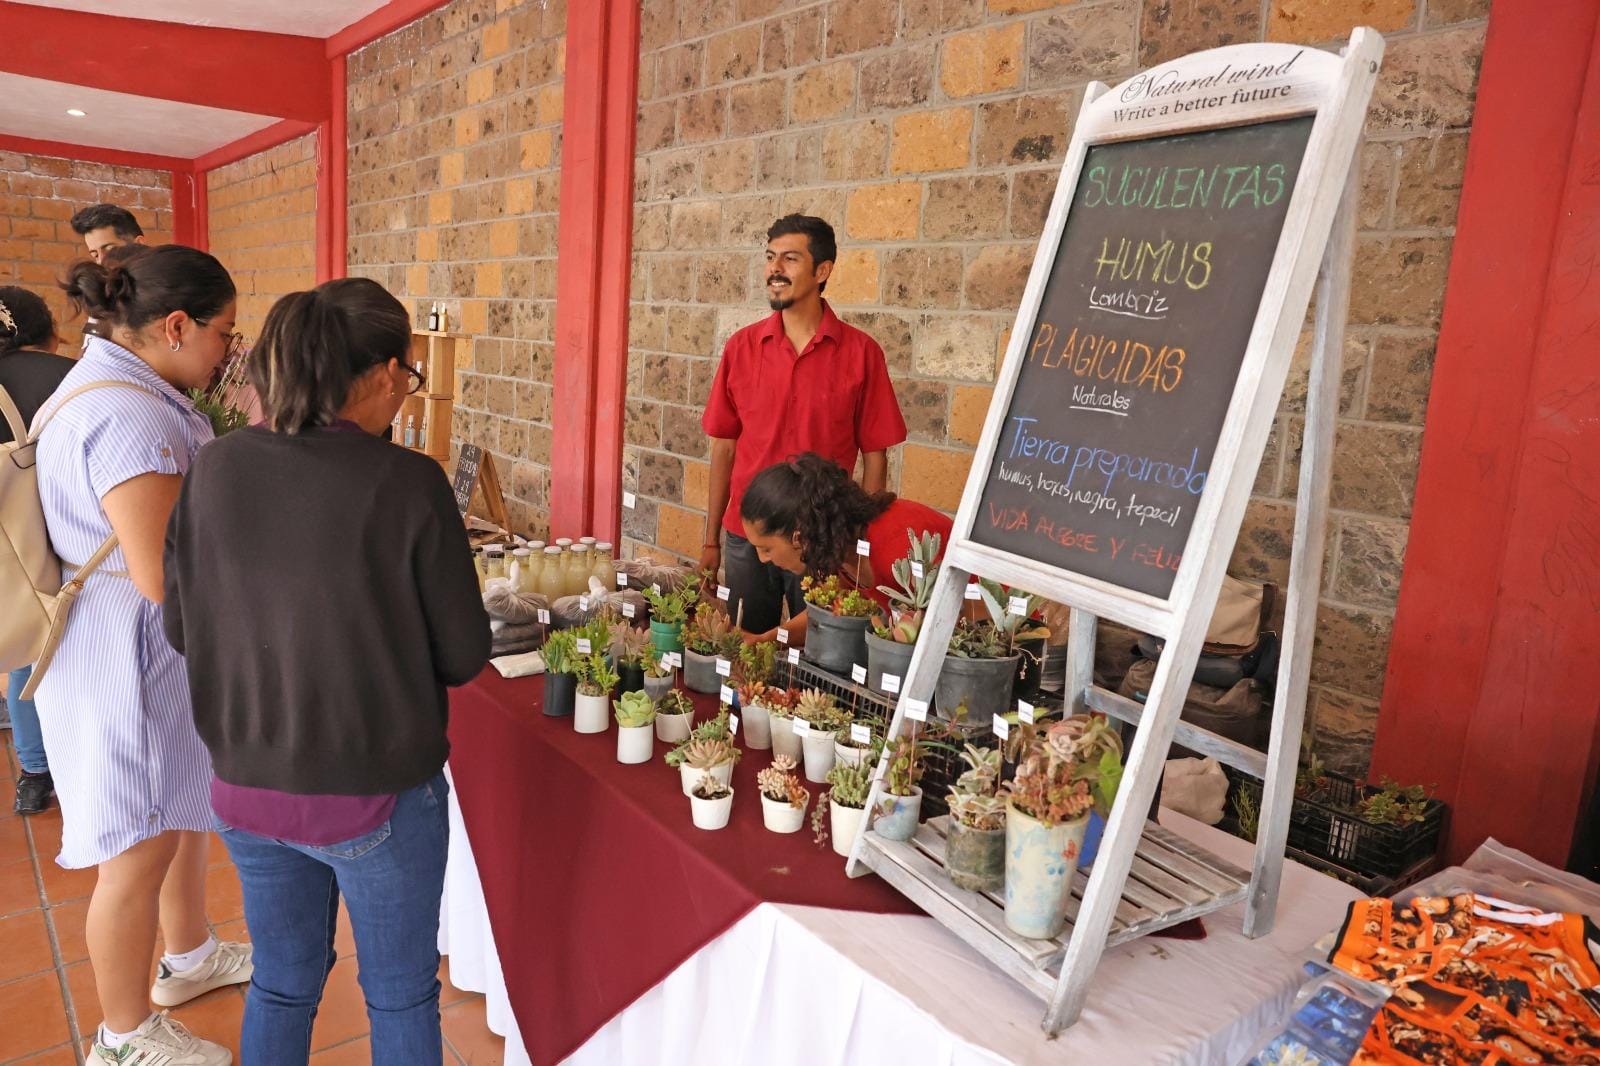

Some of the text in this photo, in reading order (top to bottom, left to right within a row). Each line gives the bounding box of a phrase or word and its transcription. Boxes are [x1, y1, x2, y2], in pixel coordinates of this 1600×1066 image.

[1120, 50, 1304, 103] Natural wind
[1114, 85, 1292, 122] Write a better future
[1096, 237, 1213, 290] HUMUS
[1030, 323, 1186, 392] PLAGICIDAS
[1072, 384, 1131, 410] Naturales
[1009, 416, 1209, 497] Tierra preparada
[988, 501, 1029, 533] VIDA
[1110, 536, 1126, 560] Y
